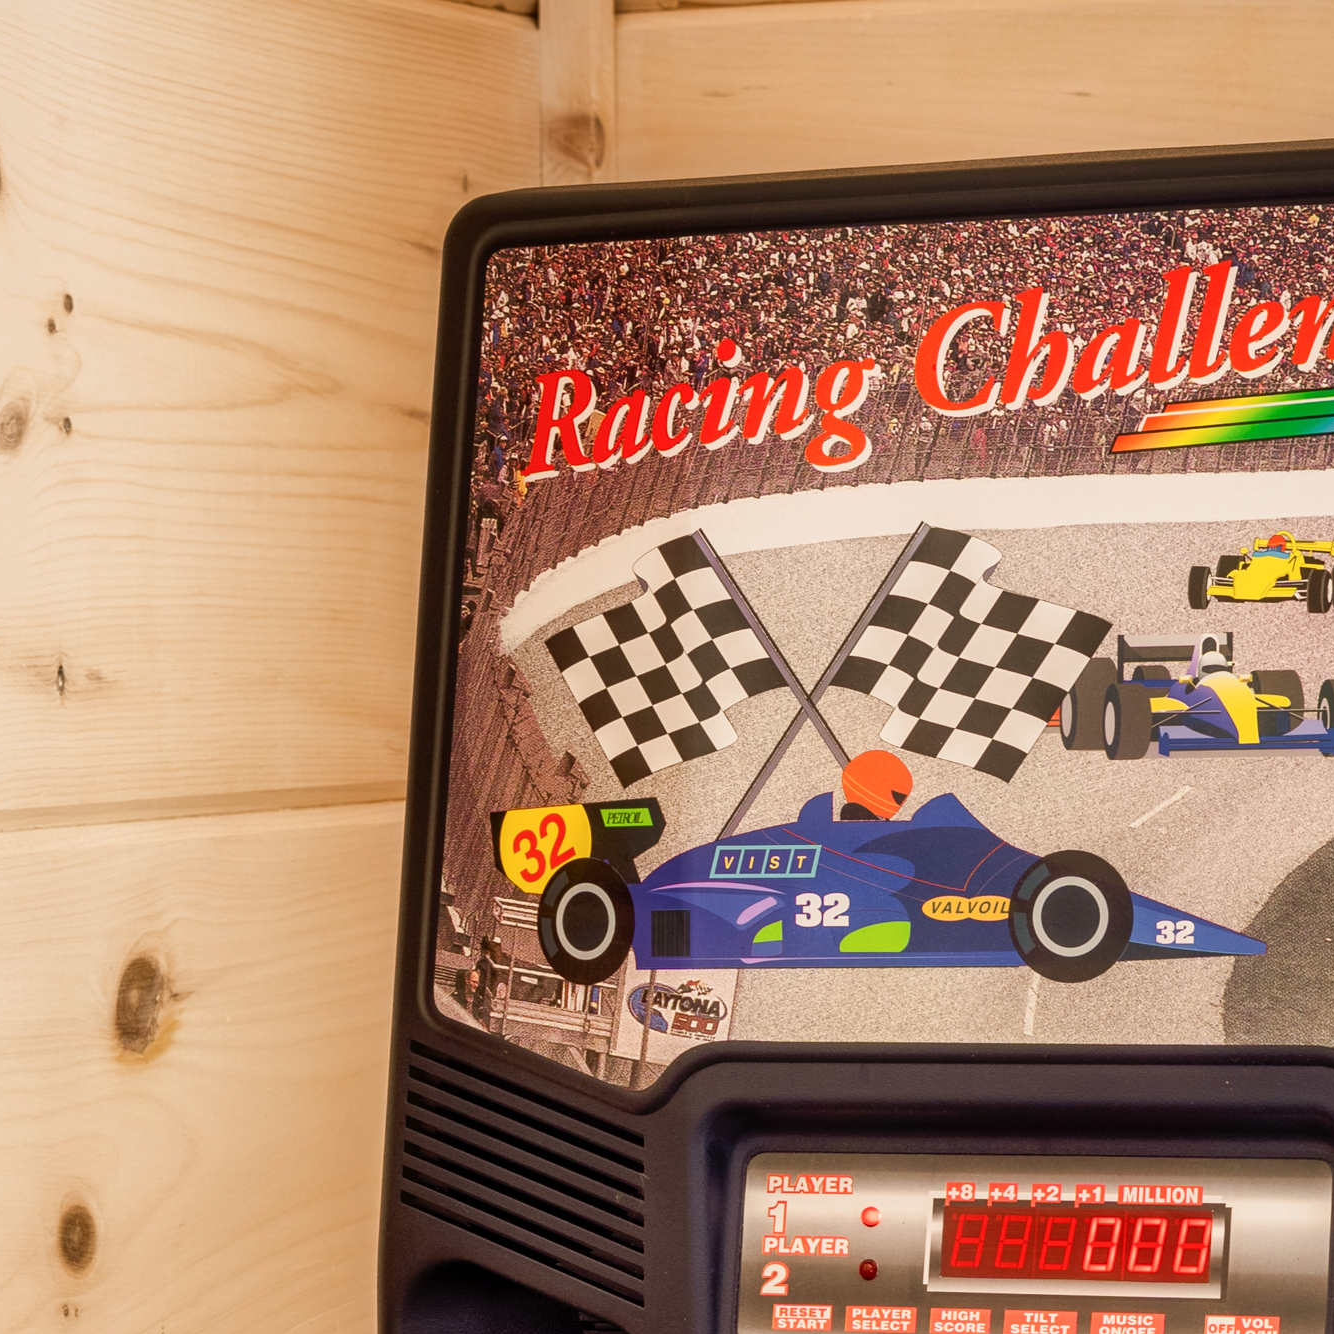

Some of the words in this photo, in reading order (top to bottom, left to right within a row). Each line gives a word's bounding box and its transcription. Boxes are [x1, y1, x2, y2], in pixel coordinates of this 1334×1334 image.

[521, 338, 875, 471] Racing
[606, 812, 643, 824] PETROIL
[513, 813, 576, 883] 32
[724, 856, 807, 869] VIST
[795, 892, 850, 927] 32
[1156, 920, 1194, 944] 32
[671, 1012, 719, 1035] 500
[768, 1175, 853, 1194] PLAYER
[947, 1184, 973, 1199] +8
[990, 1185, 1016, 1200] +4
[1033, 1186, 1059, 1201] +2
[1078, 1186, 1102, 1202] +1
[1122, 1187, 1199, 1203] MILLION
[768, 1201, 787, 1234] 1
[763, 1236, 849, 1256] PLAYER
[760, 1261, 789, 1295] 2
[778, 1307, 827, 1317] RESET
[852, 1308, 911, 1320] PLAYER
[941, 1310, 980, 1321] HIGH
[1024, 1313, 1058, 1323] TILT
[778, 1318, 827, 1329] START
[852, 1320, 910, 1331] SELECT
[1103, 1315, 1153, 1325] MUSIC
[1241, 1318, 1273, 1329] VOL
[934, 1322, 986, 1333] SCORE
[1010, 1324, 1070, 1334] SELECT
[1208, 1324, 1234, 1334] OFF
